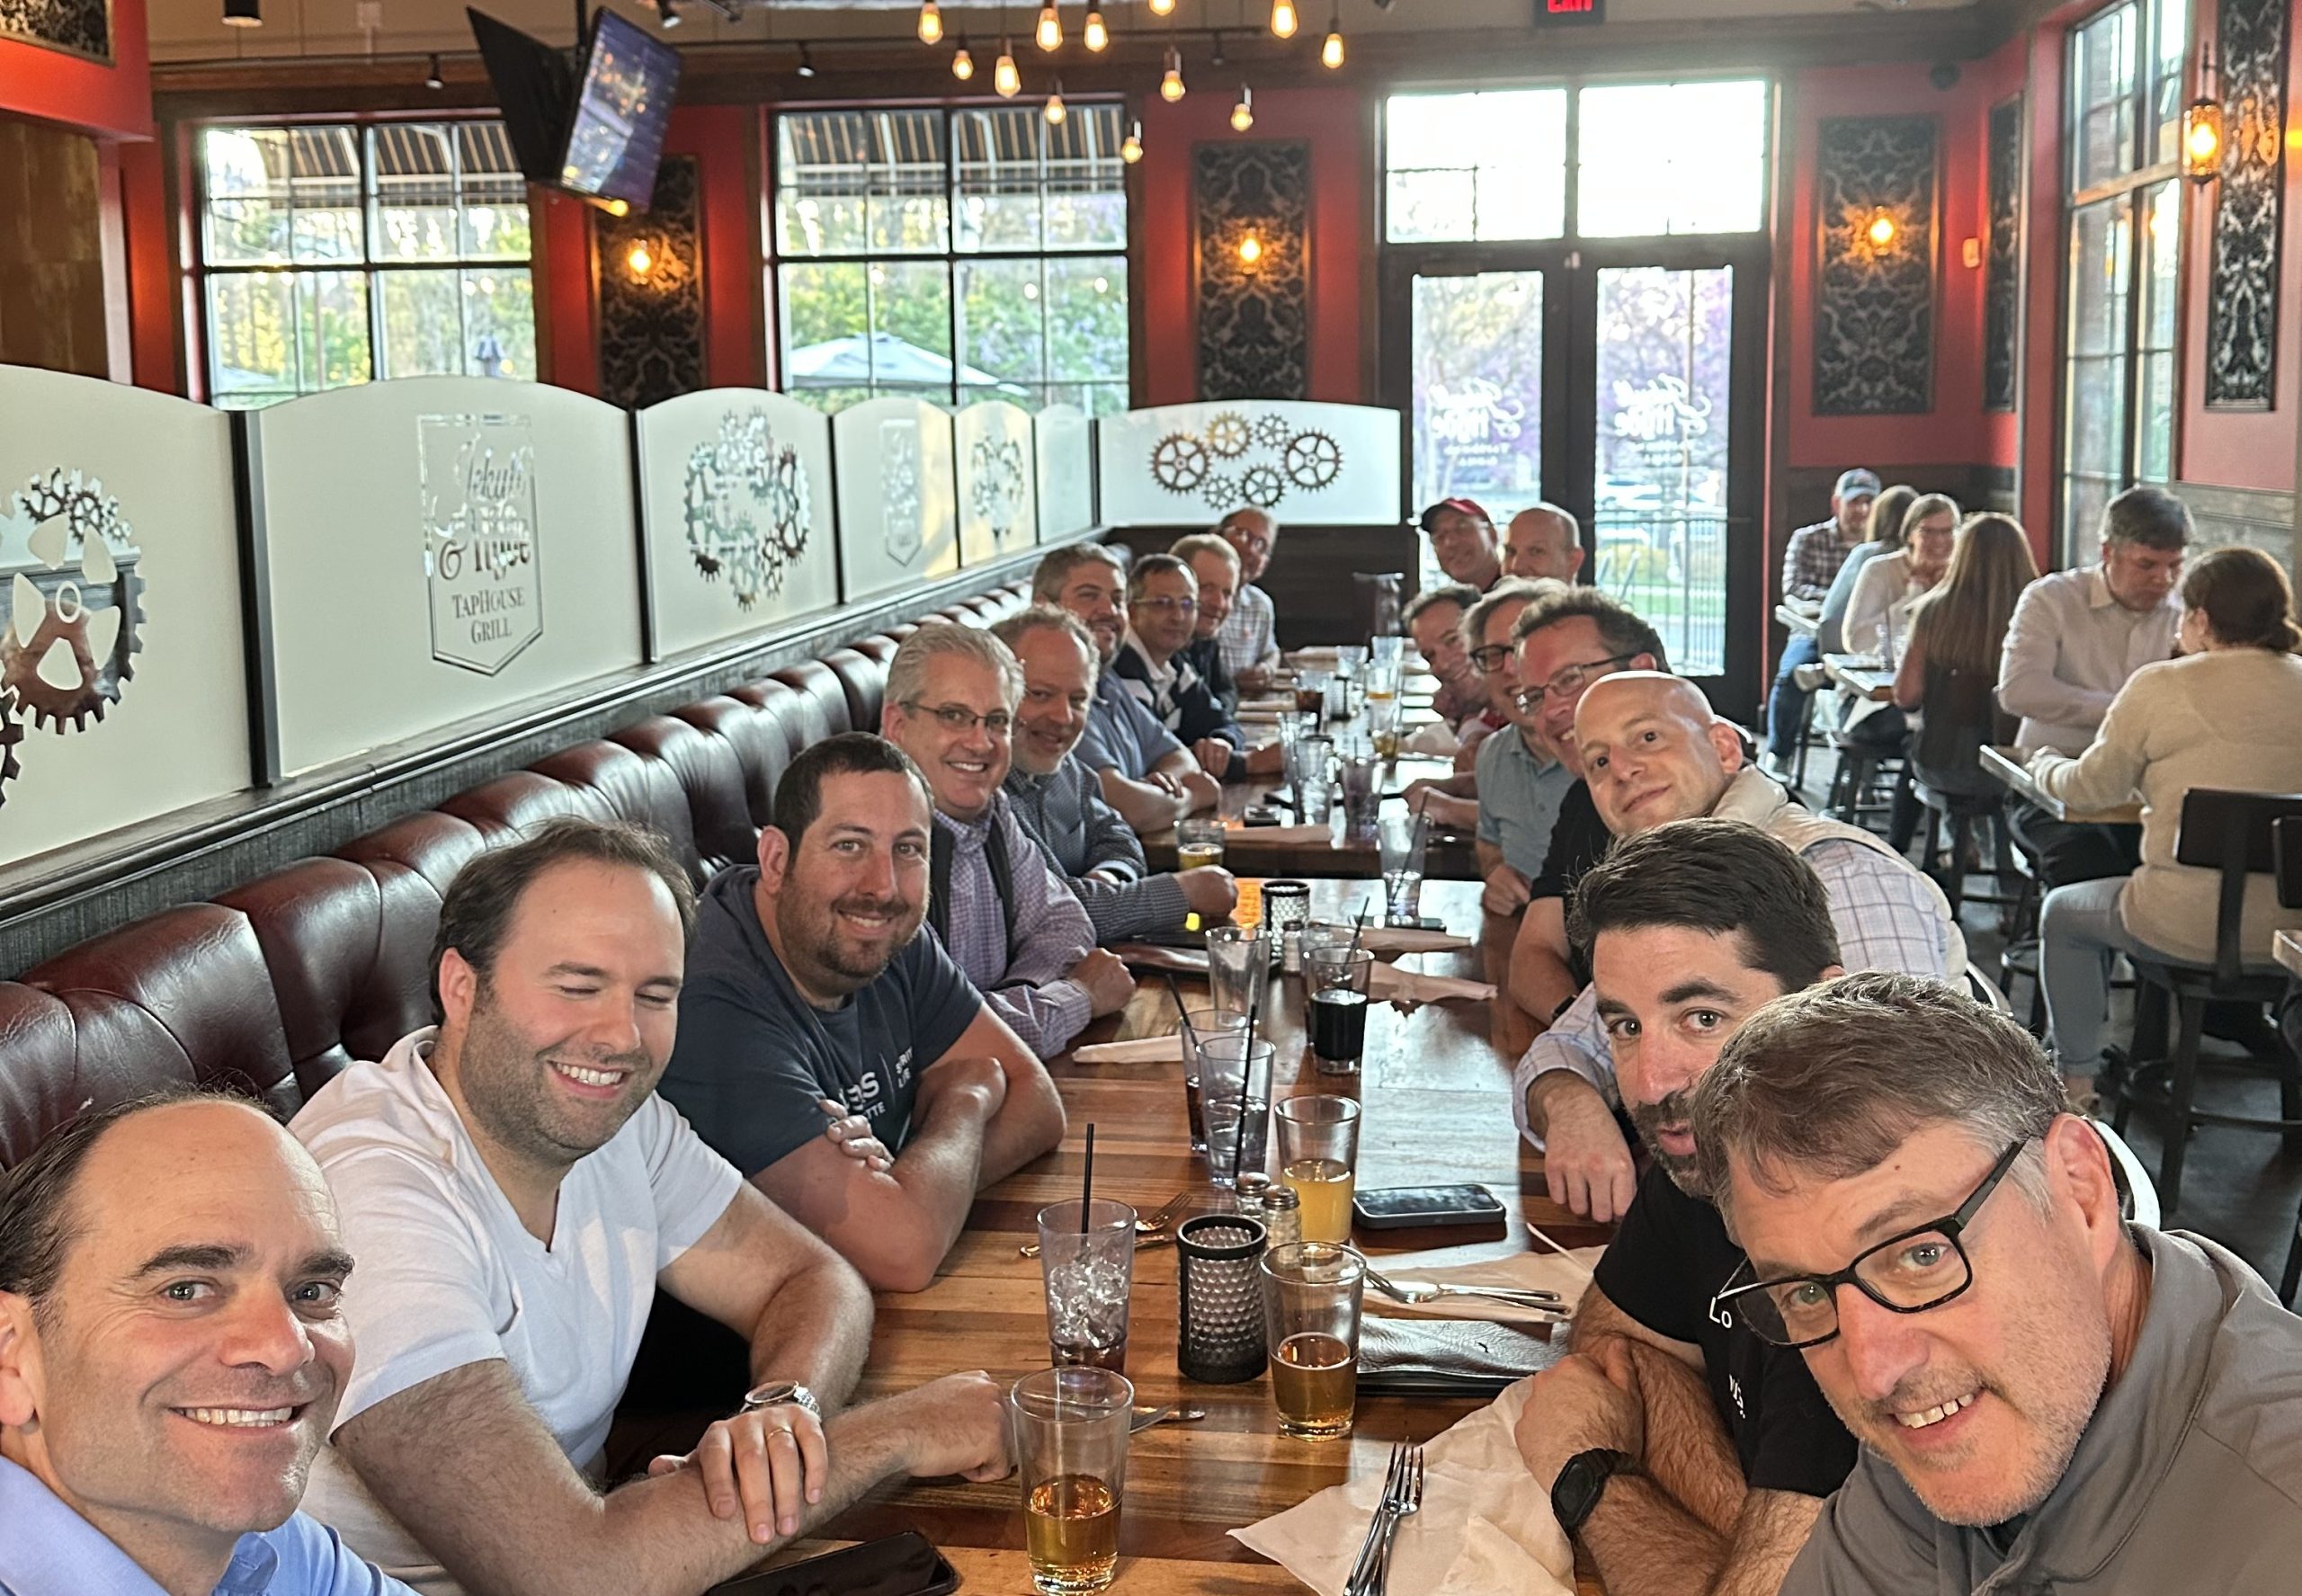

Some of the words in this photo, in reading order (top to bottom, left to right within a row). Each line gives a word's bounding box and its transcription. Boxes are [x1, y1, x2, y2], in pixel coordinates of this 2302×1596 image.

[439, 539, 468, 581] &
[451, 586, 525, 619] TAPHOUSE
[470, 617, 513, 644] GRILL
